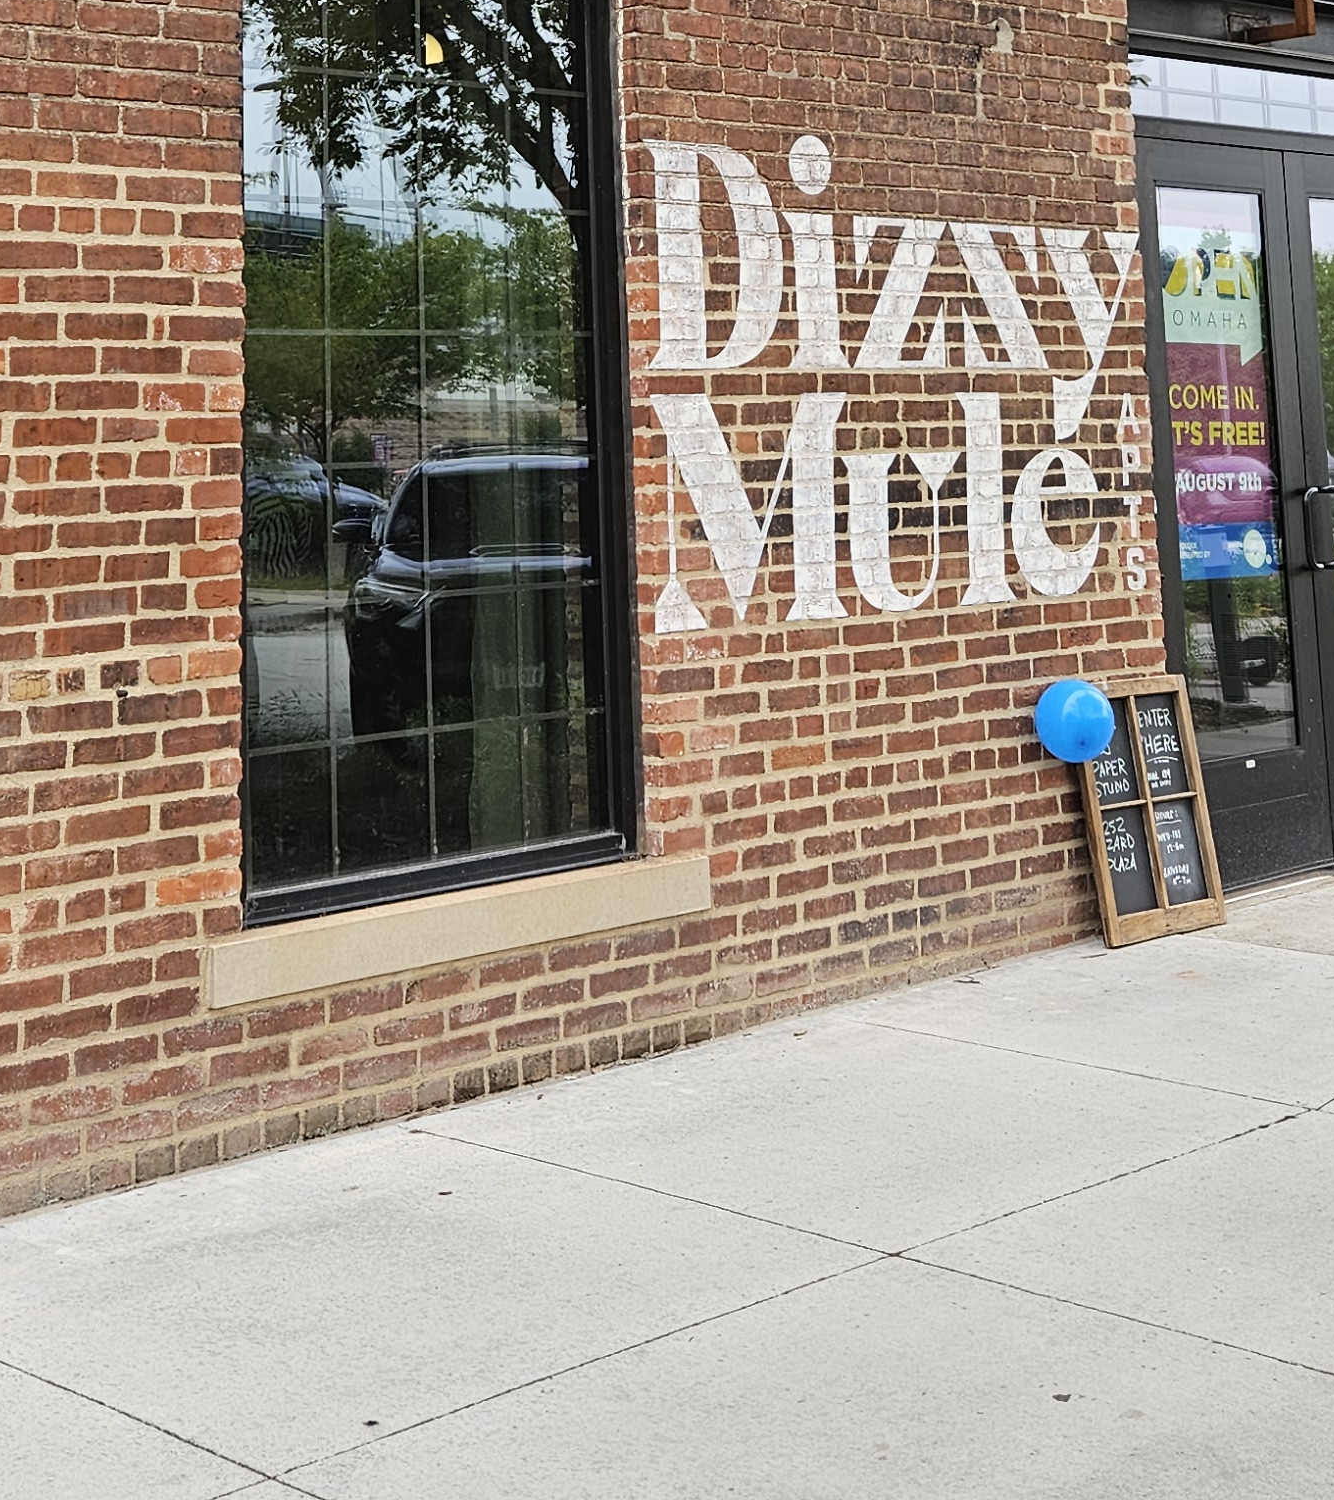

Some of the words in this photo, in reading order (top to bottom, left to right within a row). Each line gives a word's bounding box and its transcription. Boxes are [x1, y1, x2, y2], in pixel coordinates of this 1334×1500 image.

[1160, 246, 1257, 300] OPEN
[641, 135, 1140, 440] Dizzy
[1172, 309, 1247, 330] OMAHA
[1168, 384, 1229, 410] COME
[1234, 385, 1260, 410] IN.
[1171, 421, 1203, 446] T'S
[1209, 421, 1266, 446] FREE!
[1175, 472, 1236, 493] AUGUST
[1238, 471, 1263, 492] 9th
[650, 391, 1101, 634] Mule
[1137, 707, 1173, 728] ENTER
[1144, 733, 1180, 756] HERE
[1092, 757, 1128, 778] PAPER
